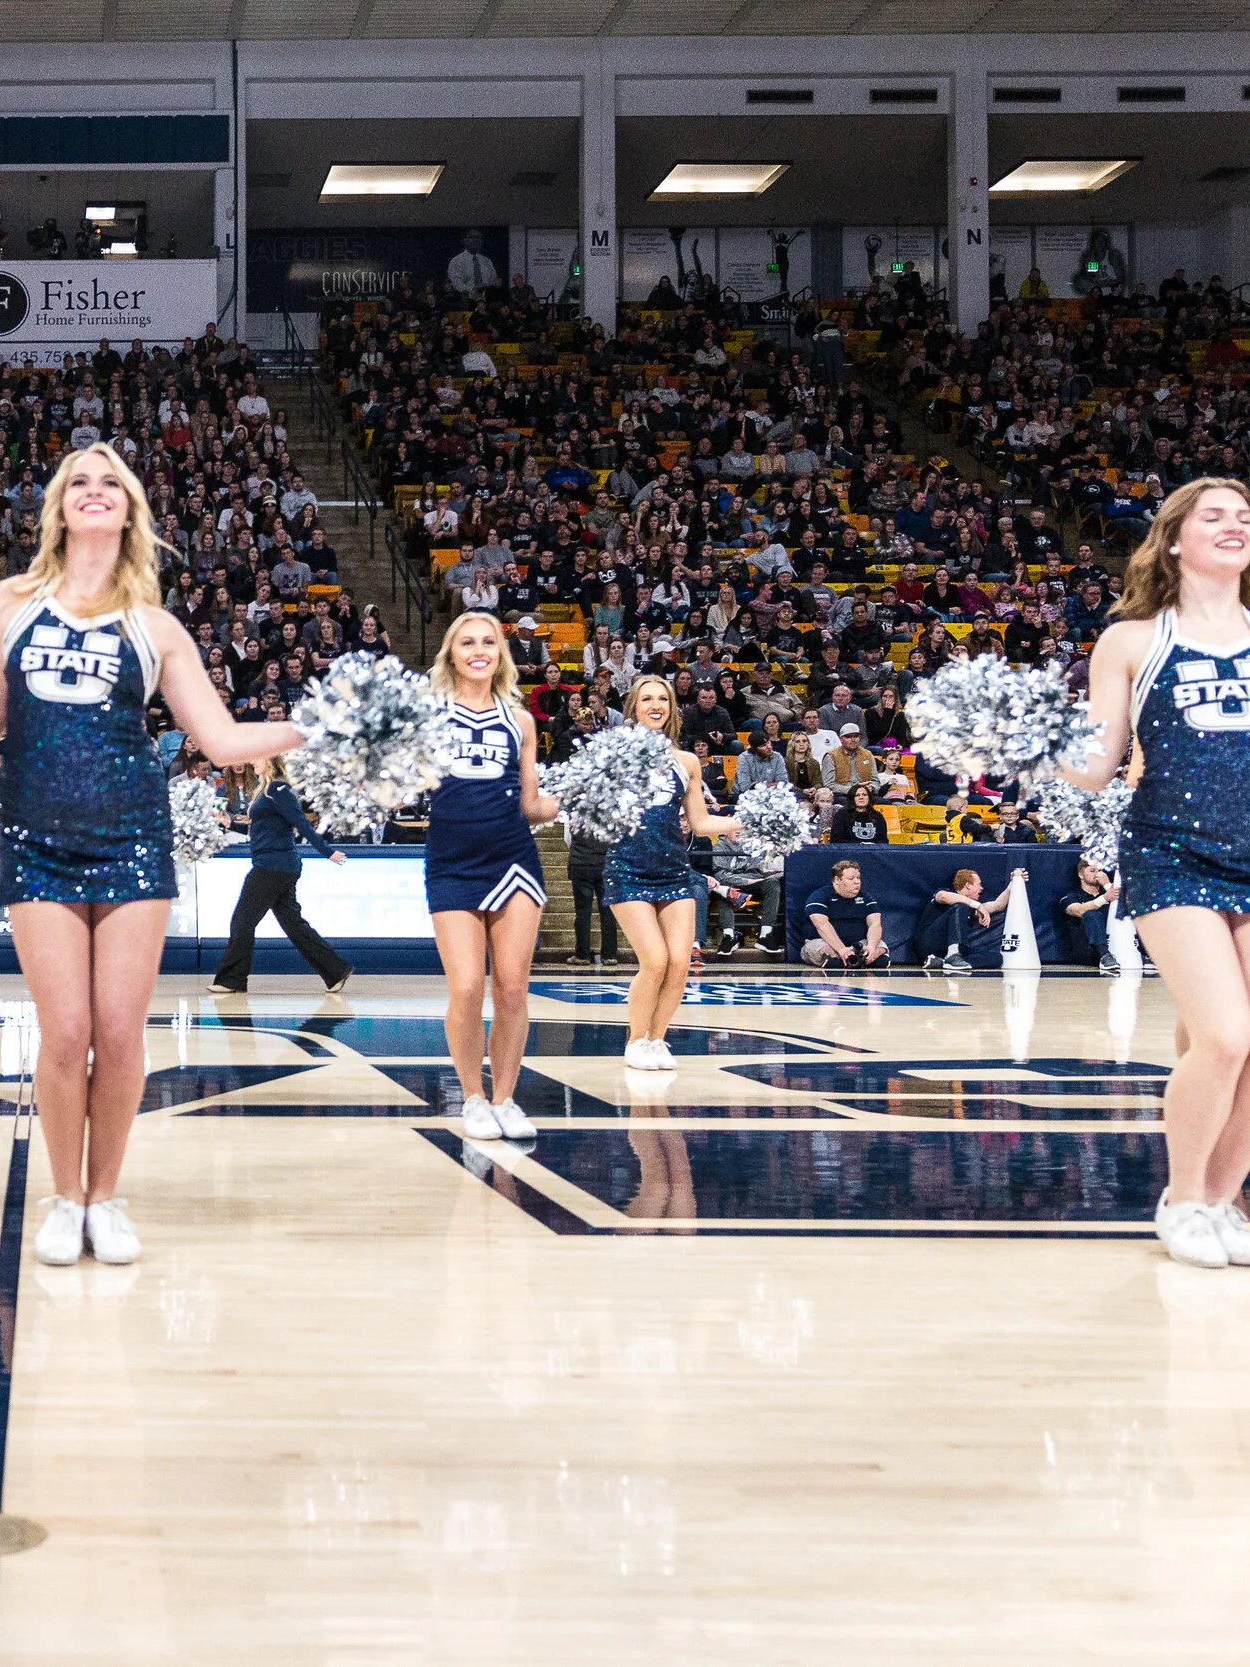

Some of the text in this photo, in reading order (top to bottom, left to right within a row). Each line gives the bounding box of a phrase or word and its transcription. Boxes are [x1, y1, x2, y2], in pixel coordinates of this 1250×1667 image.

[592, 230, 609, 247] M
[967, 228, 981, 245] N
[249, 236, 367, 263] AGGIES
[40, 277, 146, 310] Fisher
[35, 312, 151, 328] Home Furnishings
[19, 645, 122, 684] STATE
